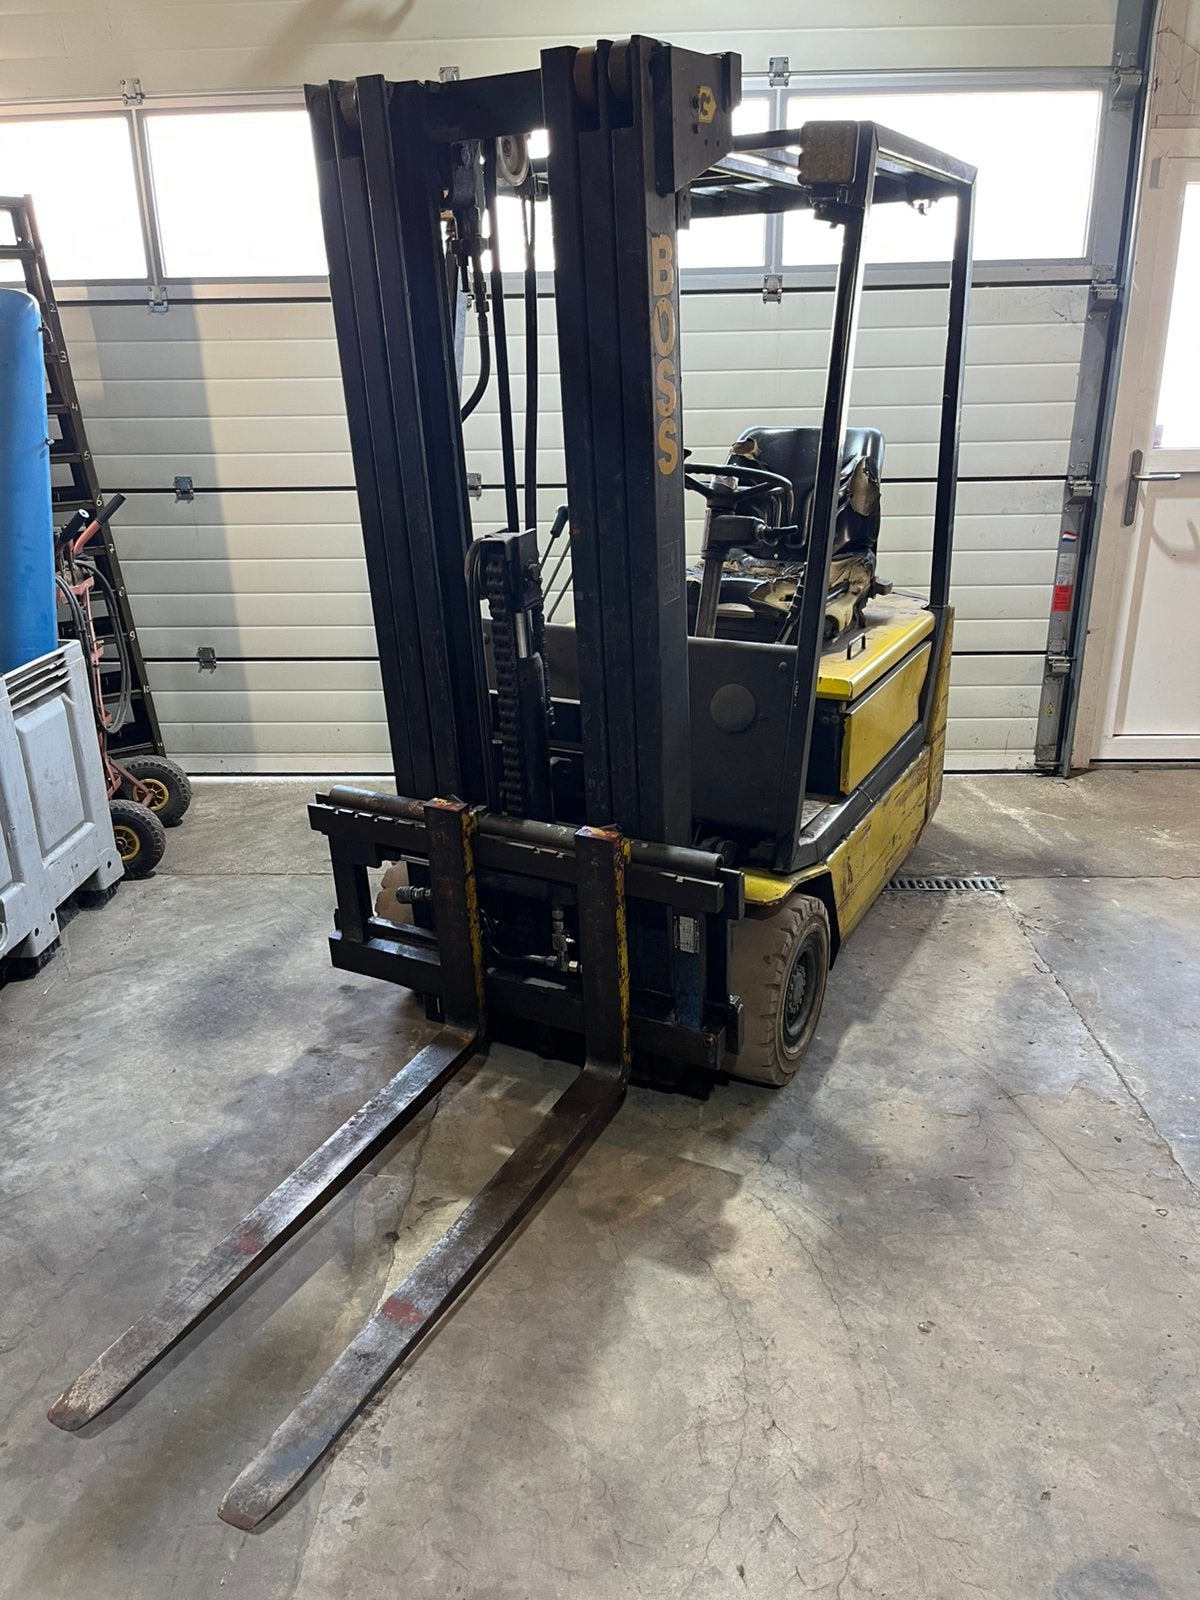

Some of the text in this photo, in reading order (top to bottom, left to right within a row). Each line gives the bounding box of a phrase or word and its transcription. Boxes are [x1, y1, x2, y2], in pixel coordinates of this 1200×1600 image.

[49, 303, 57, 313] 2
[60, 350, 68, 363] 3
[651, 233, 678, 475] BOSS
[83, 450, 91, 460] 5
[96, 494, 103, 507] 6
[129, 630, 136, 641] 9
[143, 684, 151, 694] 10
